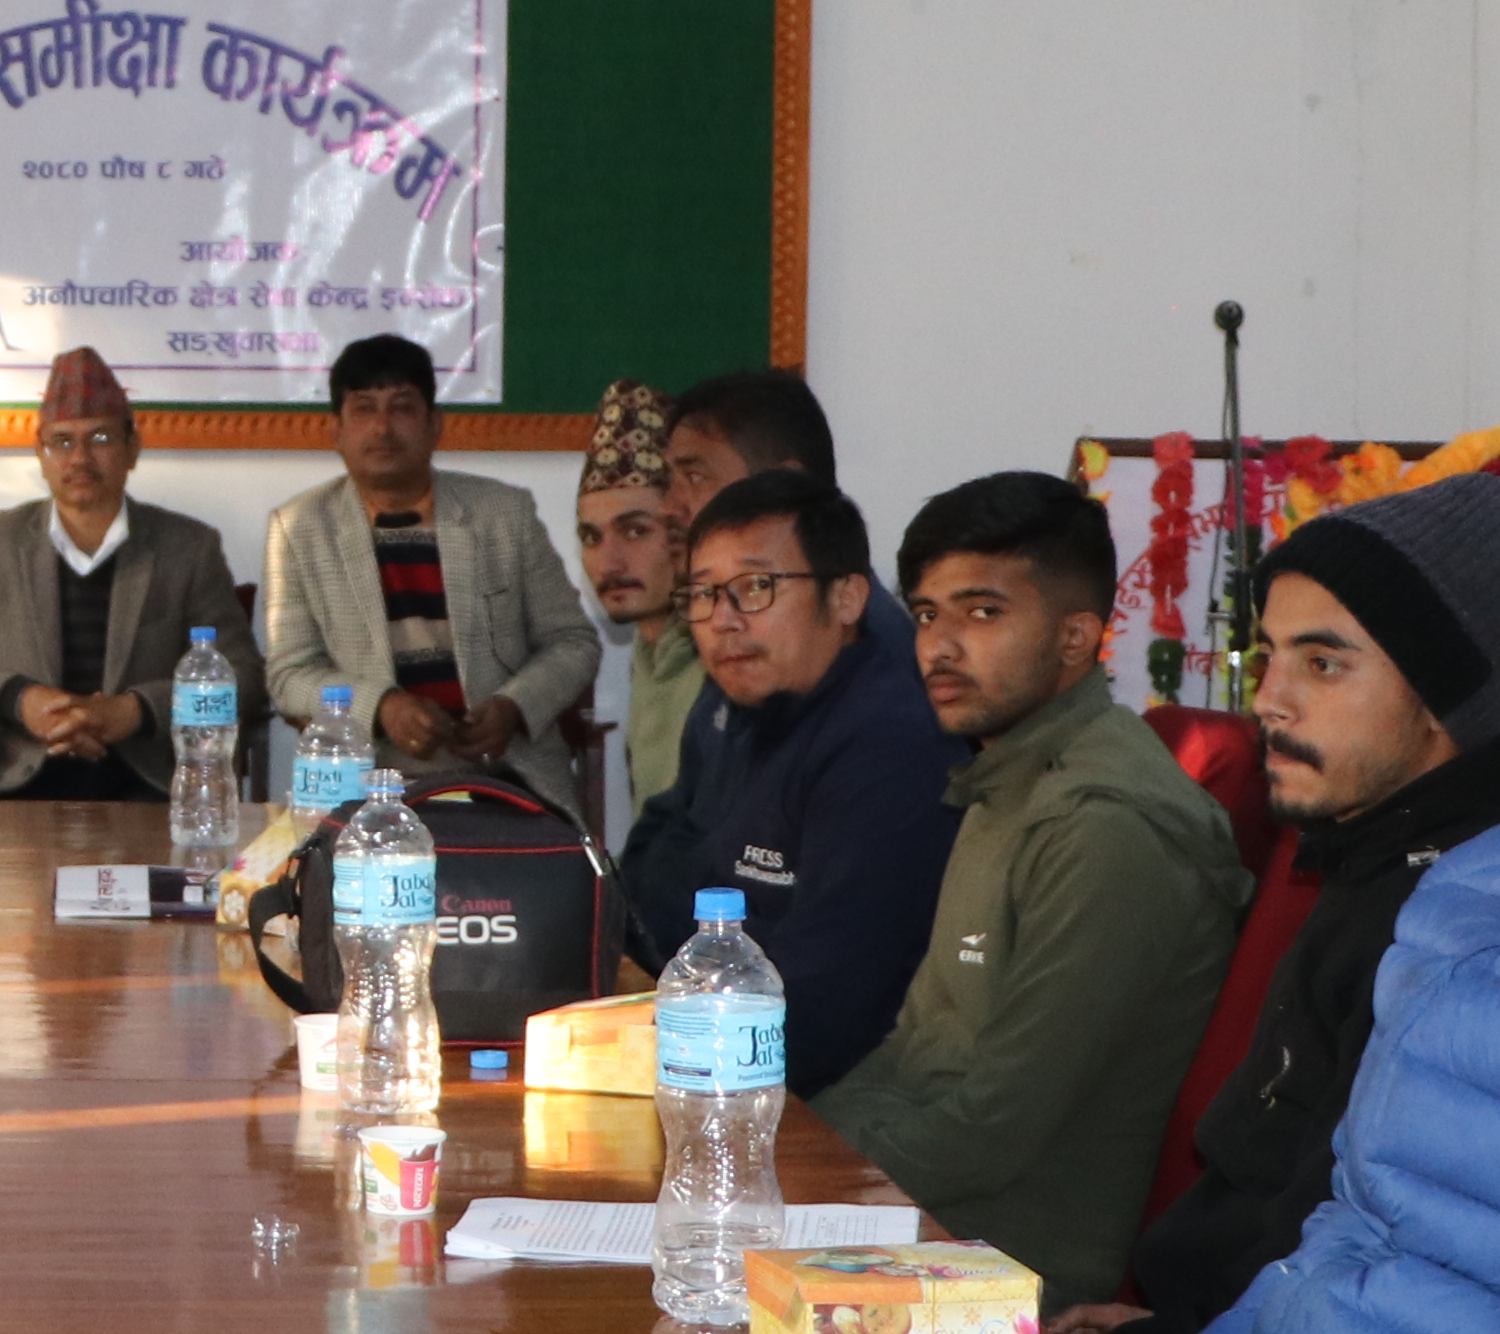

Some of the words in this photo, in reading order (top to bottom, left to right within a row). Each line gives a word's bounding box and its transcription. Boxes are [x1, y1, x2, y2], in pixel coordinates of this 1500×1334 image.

[202, 21, 462, 222] कार्यक्रम
[22, 160, 89, 181] २०८०
[99, 154, 147, 181] पौष
[157, 160, 172, 180] ८
[184, 155, 227, 180] गते
[22, 278, 180, 308] अनौपचारिक
[188, 280, 239, 310] क्षेत्र
[307, 280, 371, 311] केन्द्र
[743, 844, 784, 868] PRESS
[441, 894, 513, 913] Canon
[435, 914, 518, 945] EOS
